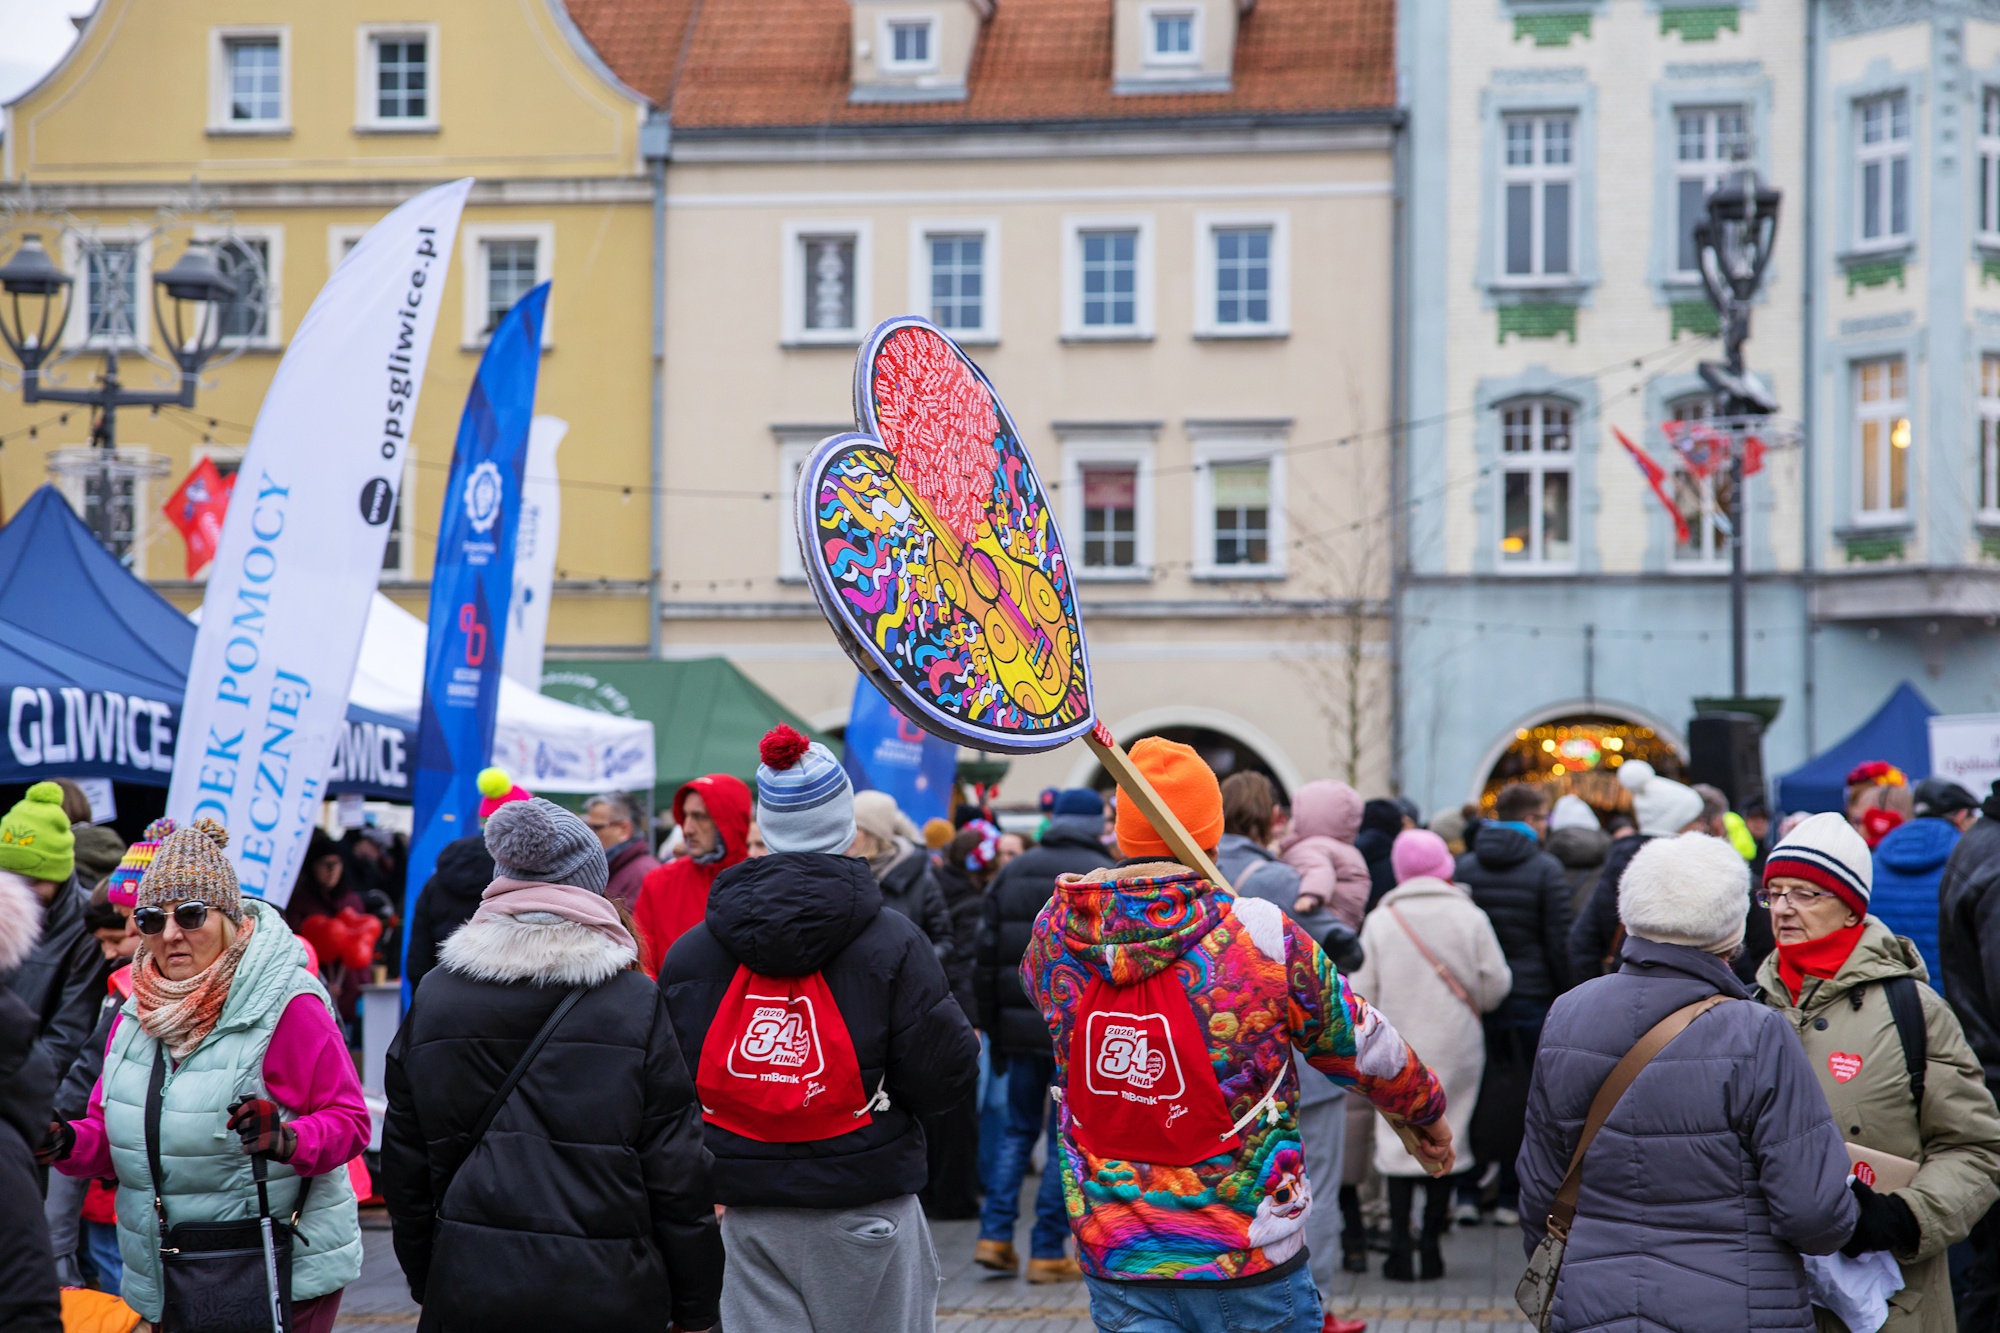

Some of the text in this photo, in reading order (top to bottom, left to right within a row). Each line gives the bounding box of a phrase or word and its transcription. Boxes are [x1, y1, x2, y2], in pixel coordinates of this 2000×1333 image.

[381, 226, 437, 460] opsgliwice.pl
[216, 468, 290, 708] POMOCY
[8, 686, 173, 773] GLIWICE
[757, 1009, 783, 1017] 2026
[1108, 1028, 1133, 1036] 2026
[744, 1018, 799, 1056] 34
[1101, 1036, 1148, 1074] 34
[760, 1072, 799, 1084] mBank
[1121, 1090, 1157, 1105] mBank
